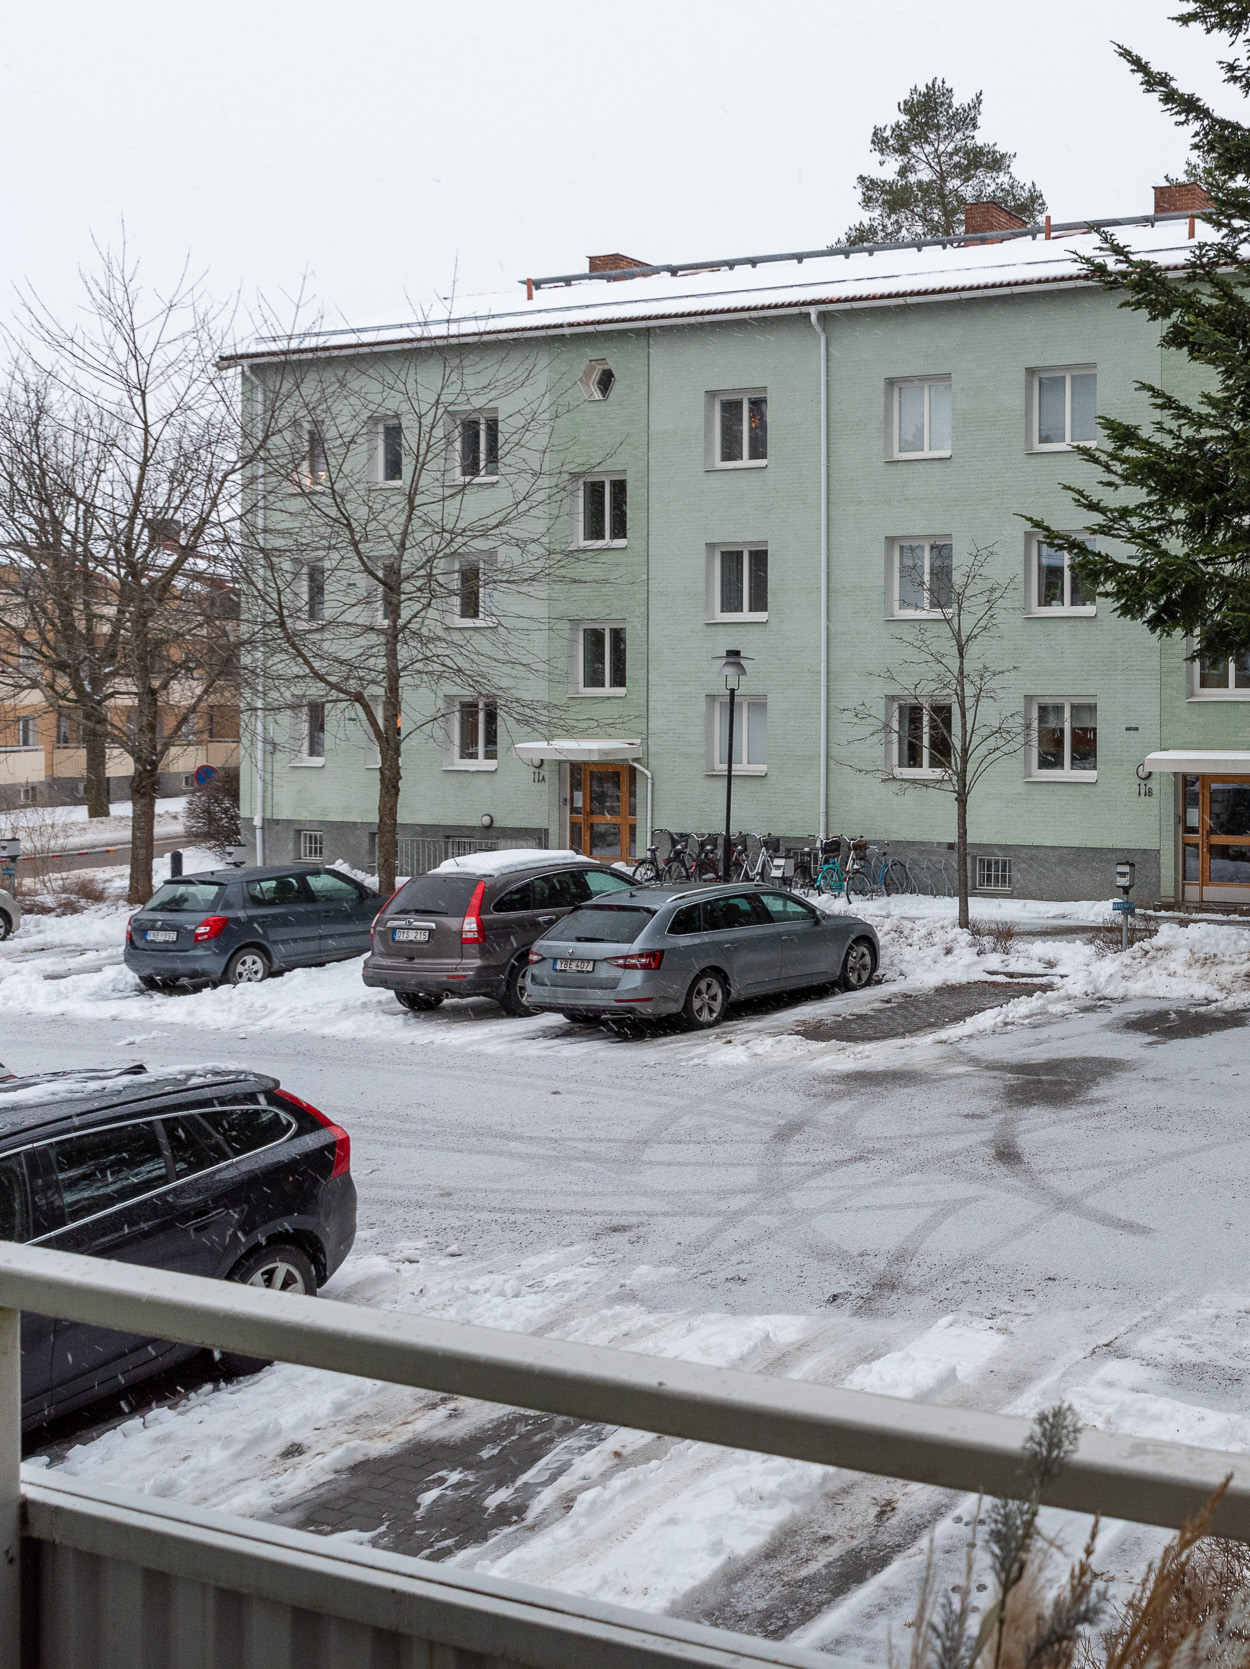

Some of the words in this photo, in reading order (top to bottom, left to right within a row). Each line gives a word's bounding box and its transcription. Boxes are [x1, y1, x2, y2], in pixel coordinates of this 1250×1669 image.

[1137, 783, 1153, 797] 11B
[414, 931, 427, 939] 215
[560, 960, 573, 969] YBE
[575, 961, 590, 969] 407
